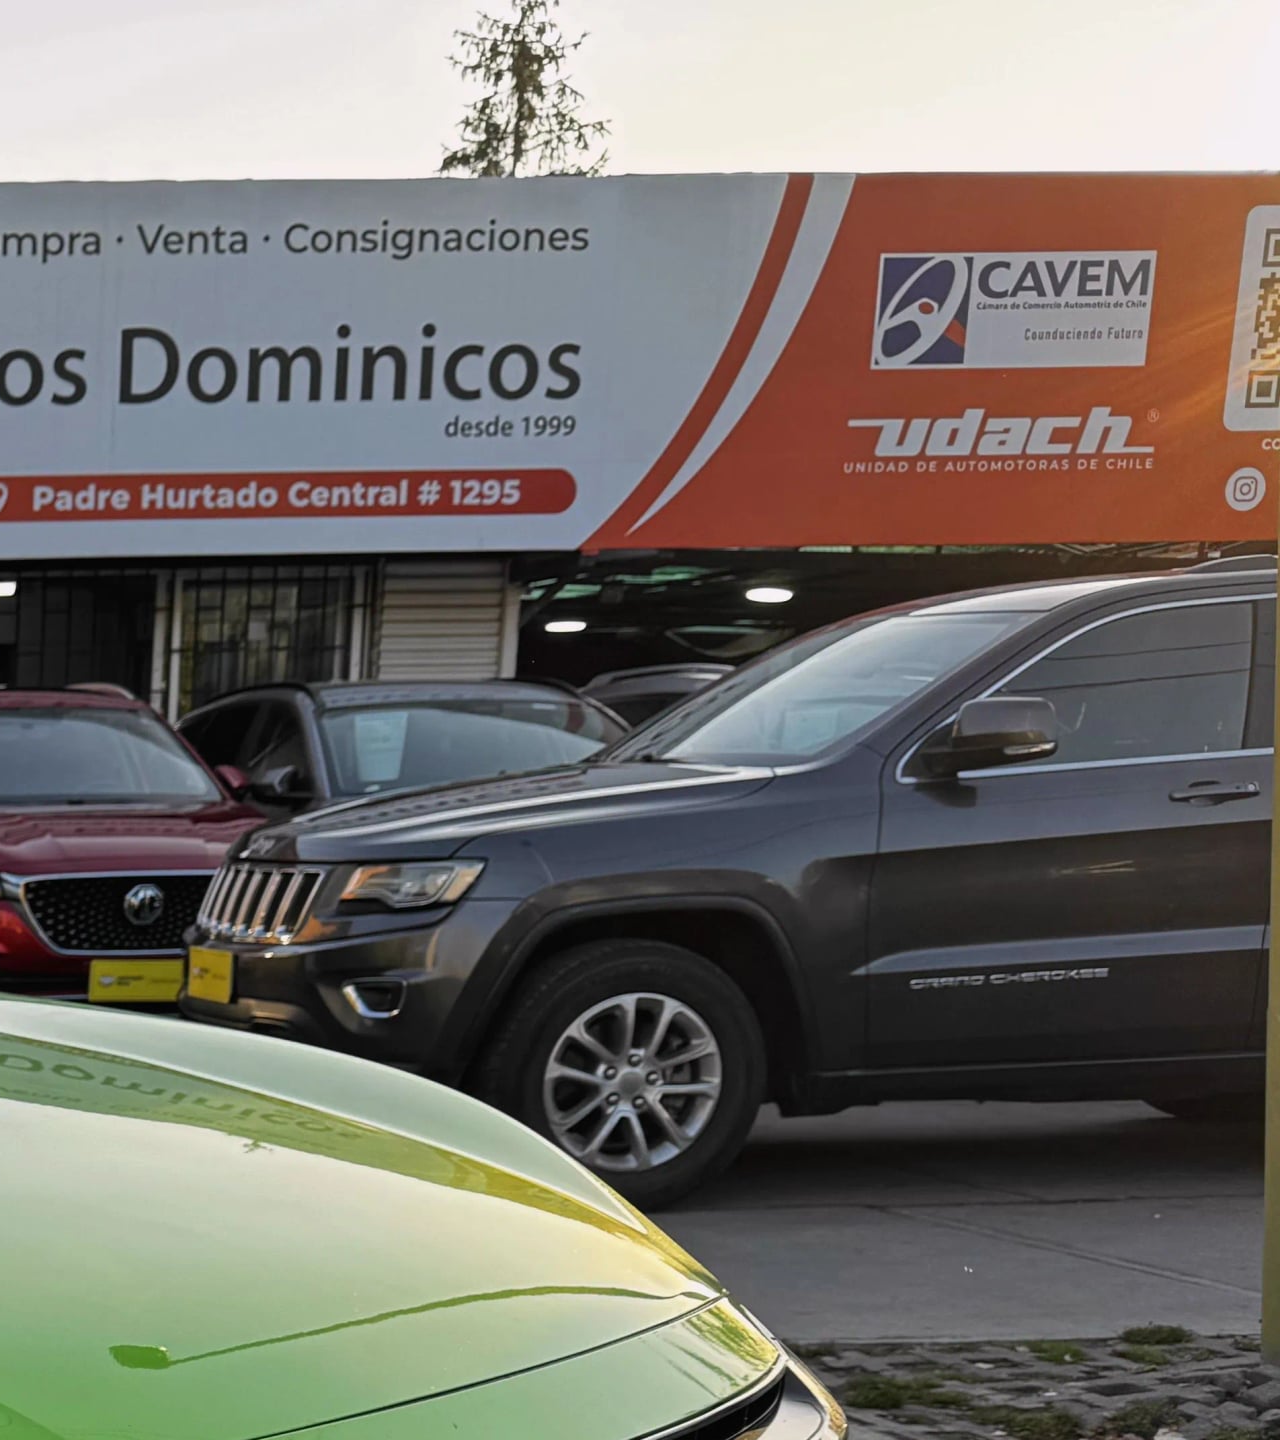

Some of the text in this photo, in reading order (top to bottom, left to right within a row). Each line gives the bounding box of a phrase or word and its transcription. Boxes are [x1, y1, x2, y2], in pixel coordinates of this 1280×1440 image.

[136, 223, 248, 255] Venta
[283, 218, 589, 261] Consignaciones
[977, 258, 1152, 300] CAVEM
[976, 299, 1148, 311] Cámara de Comercio Automotriz de Chile
[1108, 327, 1143, 339] Futuro
[118, 323, 581, 405] Dominicos
[444, 415, 577, 438] desde 1999
[847, 406, 1155, 457] udach
[844, 458, 1153, 473] UNIDAD DE AUTOMOTORAS DE CHILE
[32, 478, 521, 512] Padre Hurtado Central # 1295
[909, 967, 1110, 990] GRAND CHEROKEE
